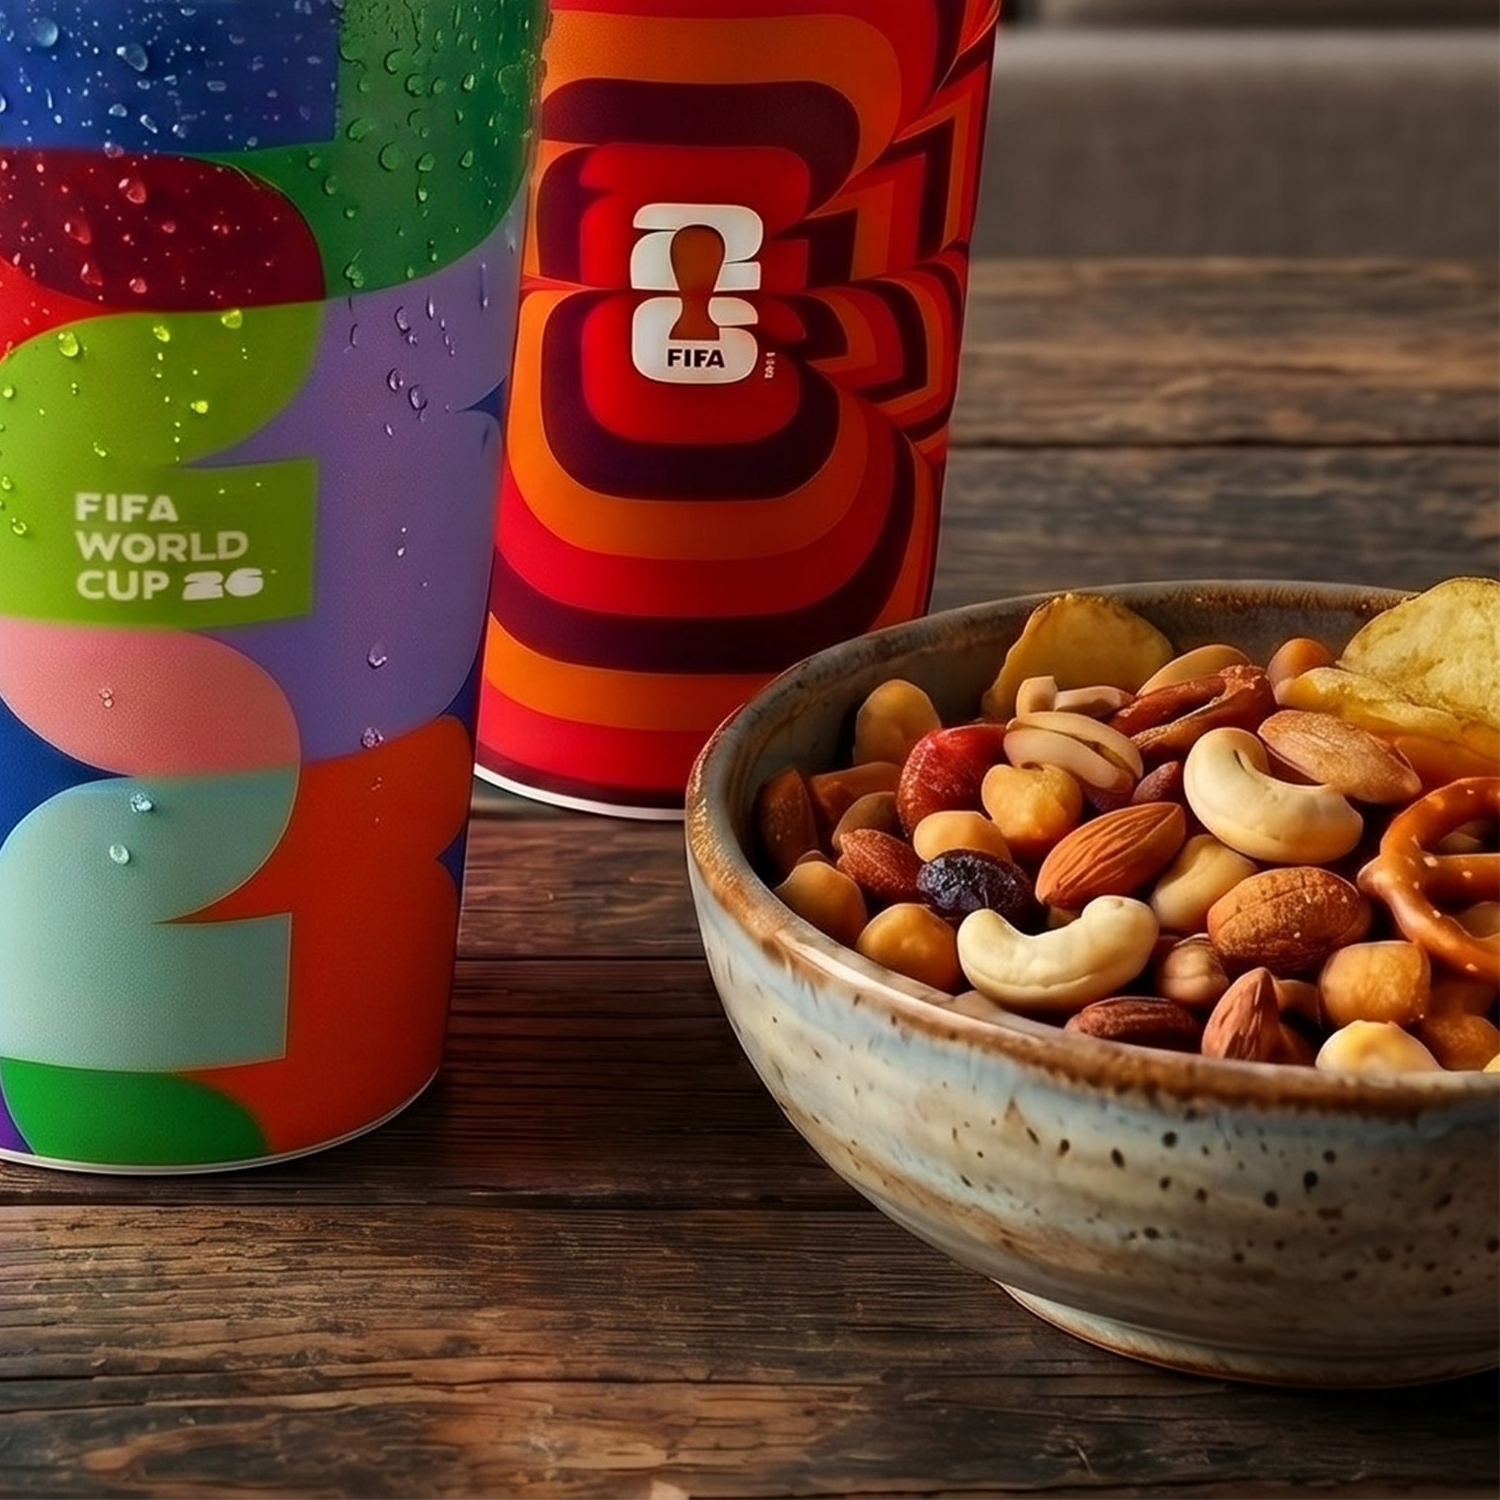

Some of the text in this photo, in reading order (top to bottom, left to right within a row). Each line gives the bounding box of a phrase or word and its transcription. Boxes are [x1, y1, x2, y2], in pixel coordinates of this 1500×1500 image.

[667, 349, 725, 368] FIFA
[75, 492, 179, 523] FIFA
[75, 530, 249, 563] WORLD
[76, 566, 265, 601] CUP 26
